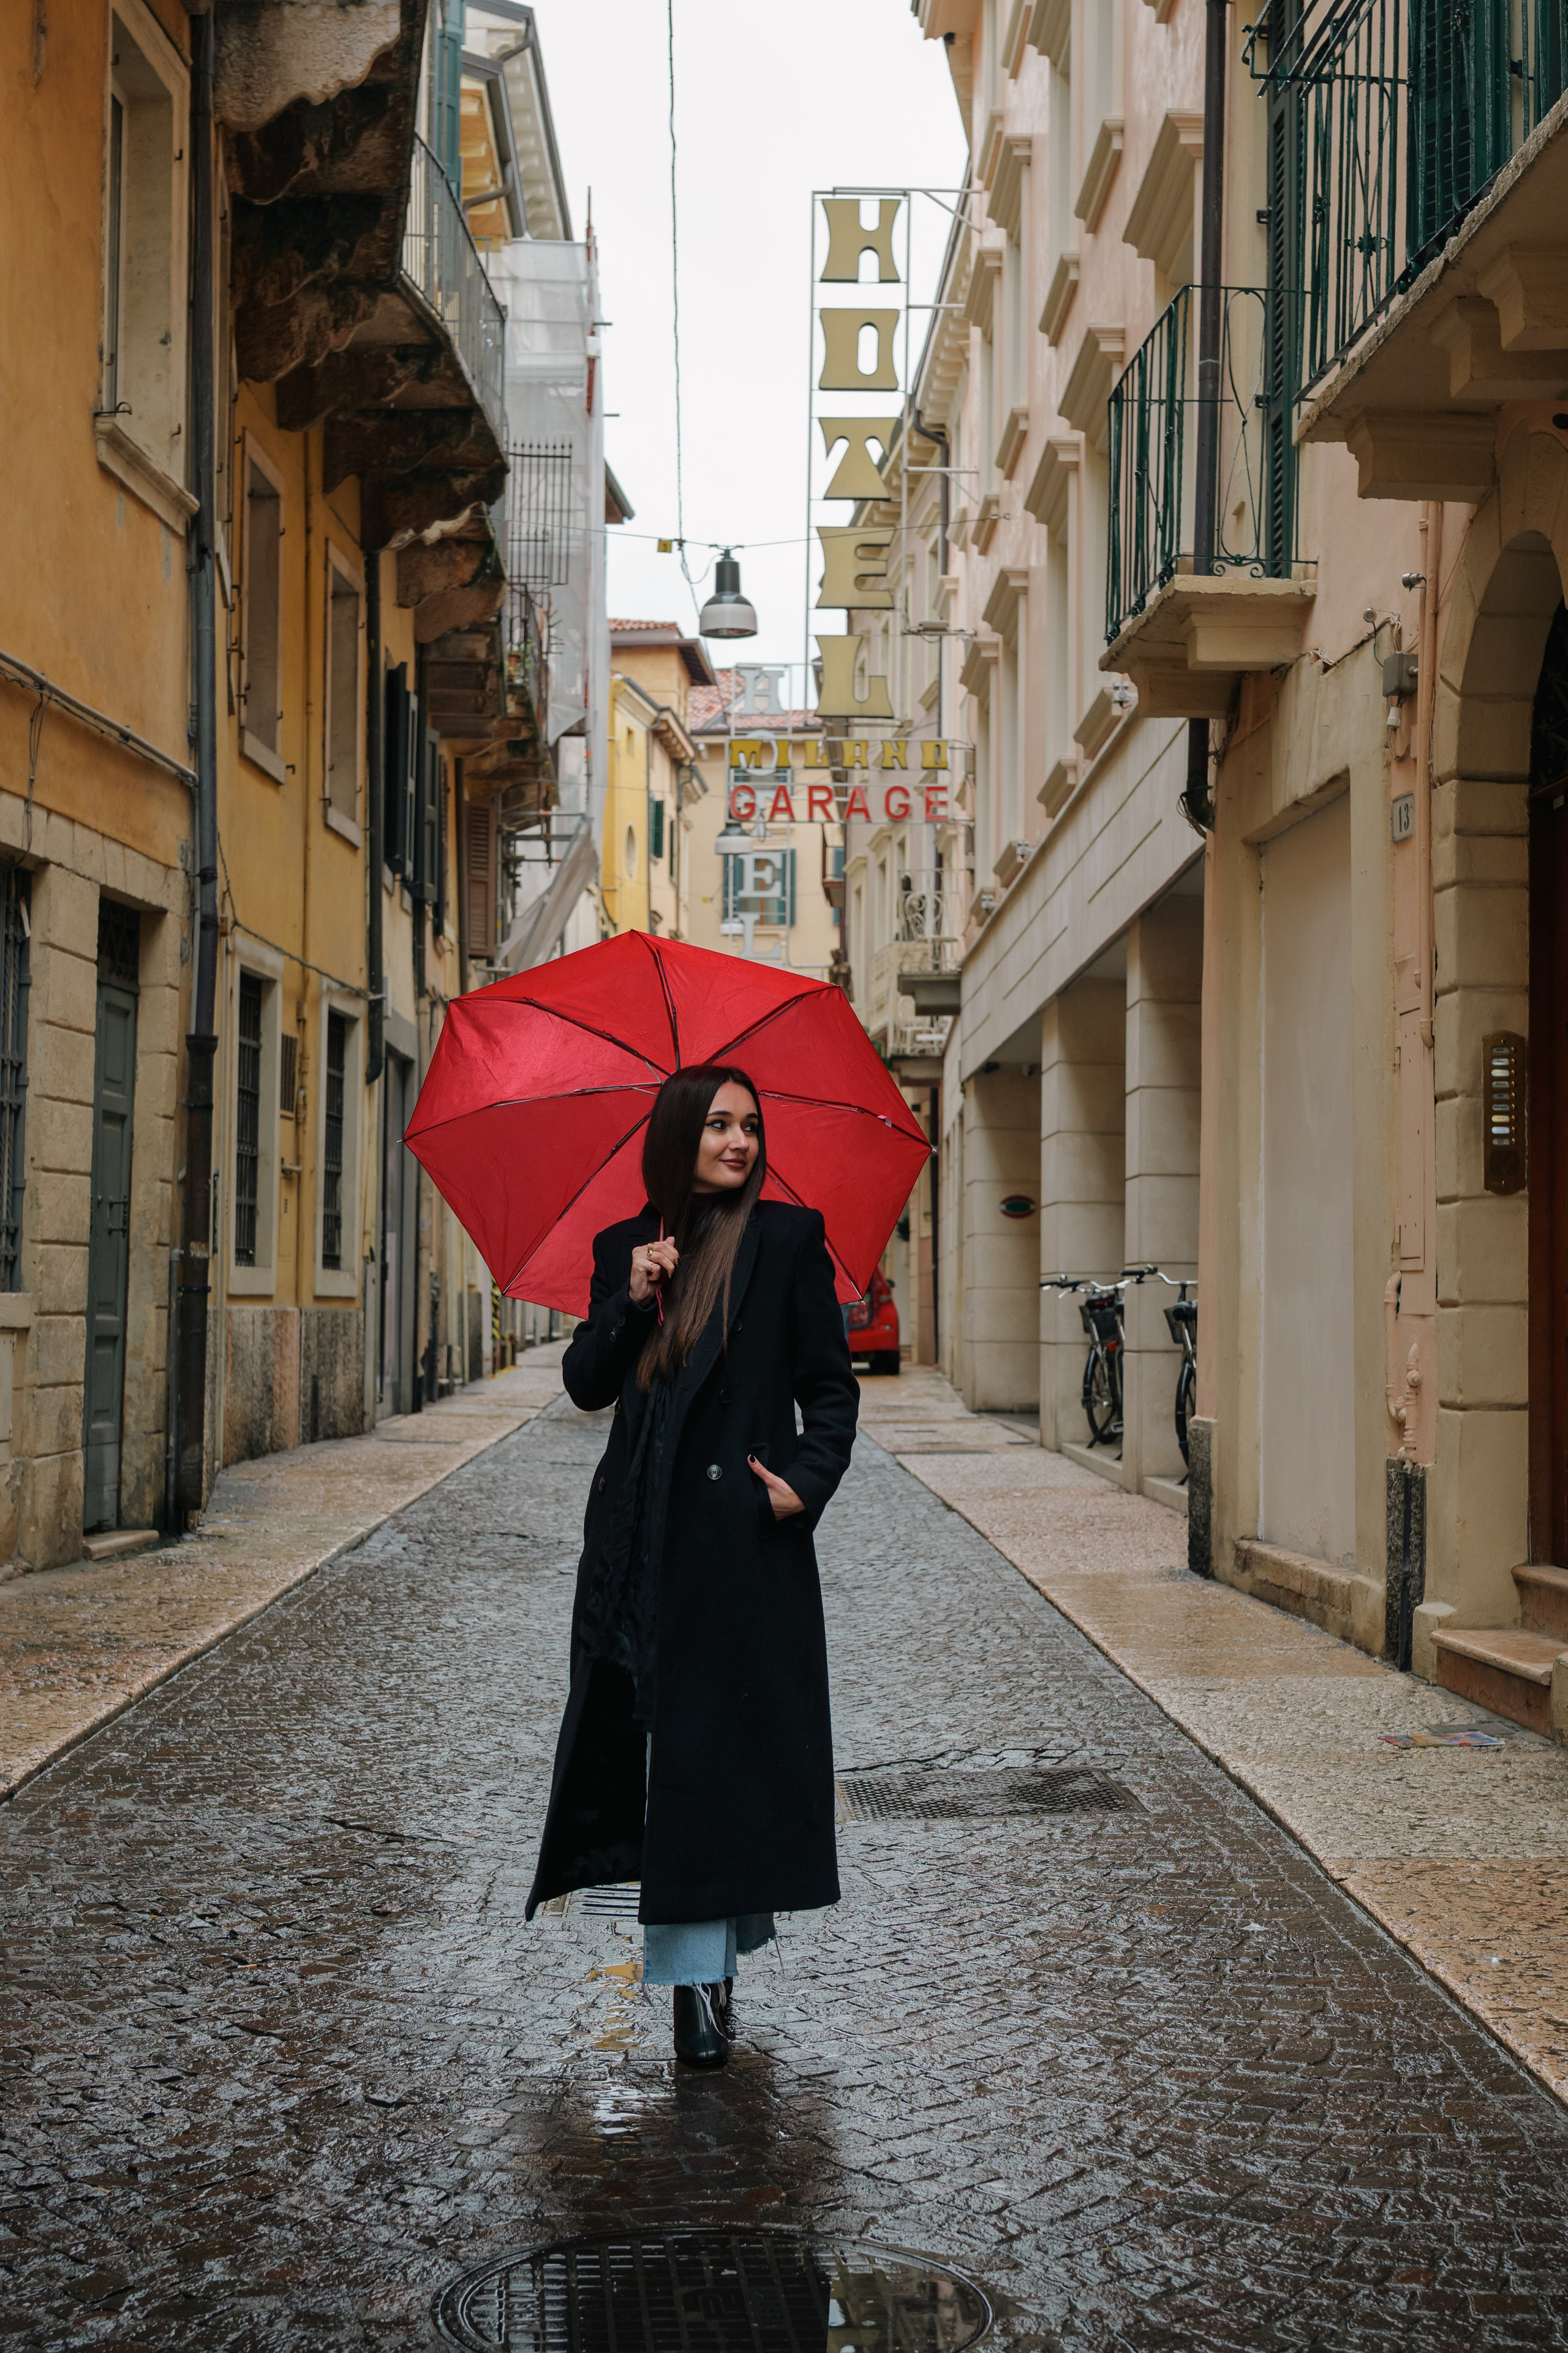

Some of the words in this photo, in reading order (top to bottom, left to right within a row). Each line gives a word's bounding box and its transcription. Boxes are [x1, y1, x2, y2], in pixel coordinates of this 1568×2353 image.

[815, 199, 901, 717] HOTEL
[729, 739, 949, 769] MILANO
[730, 785, 948, 821] GARAGE
[738, 670, 785, 959] HOTEL
